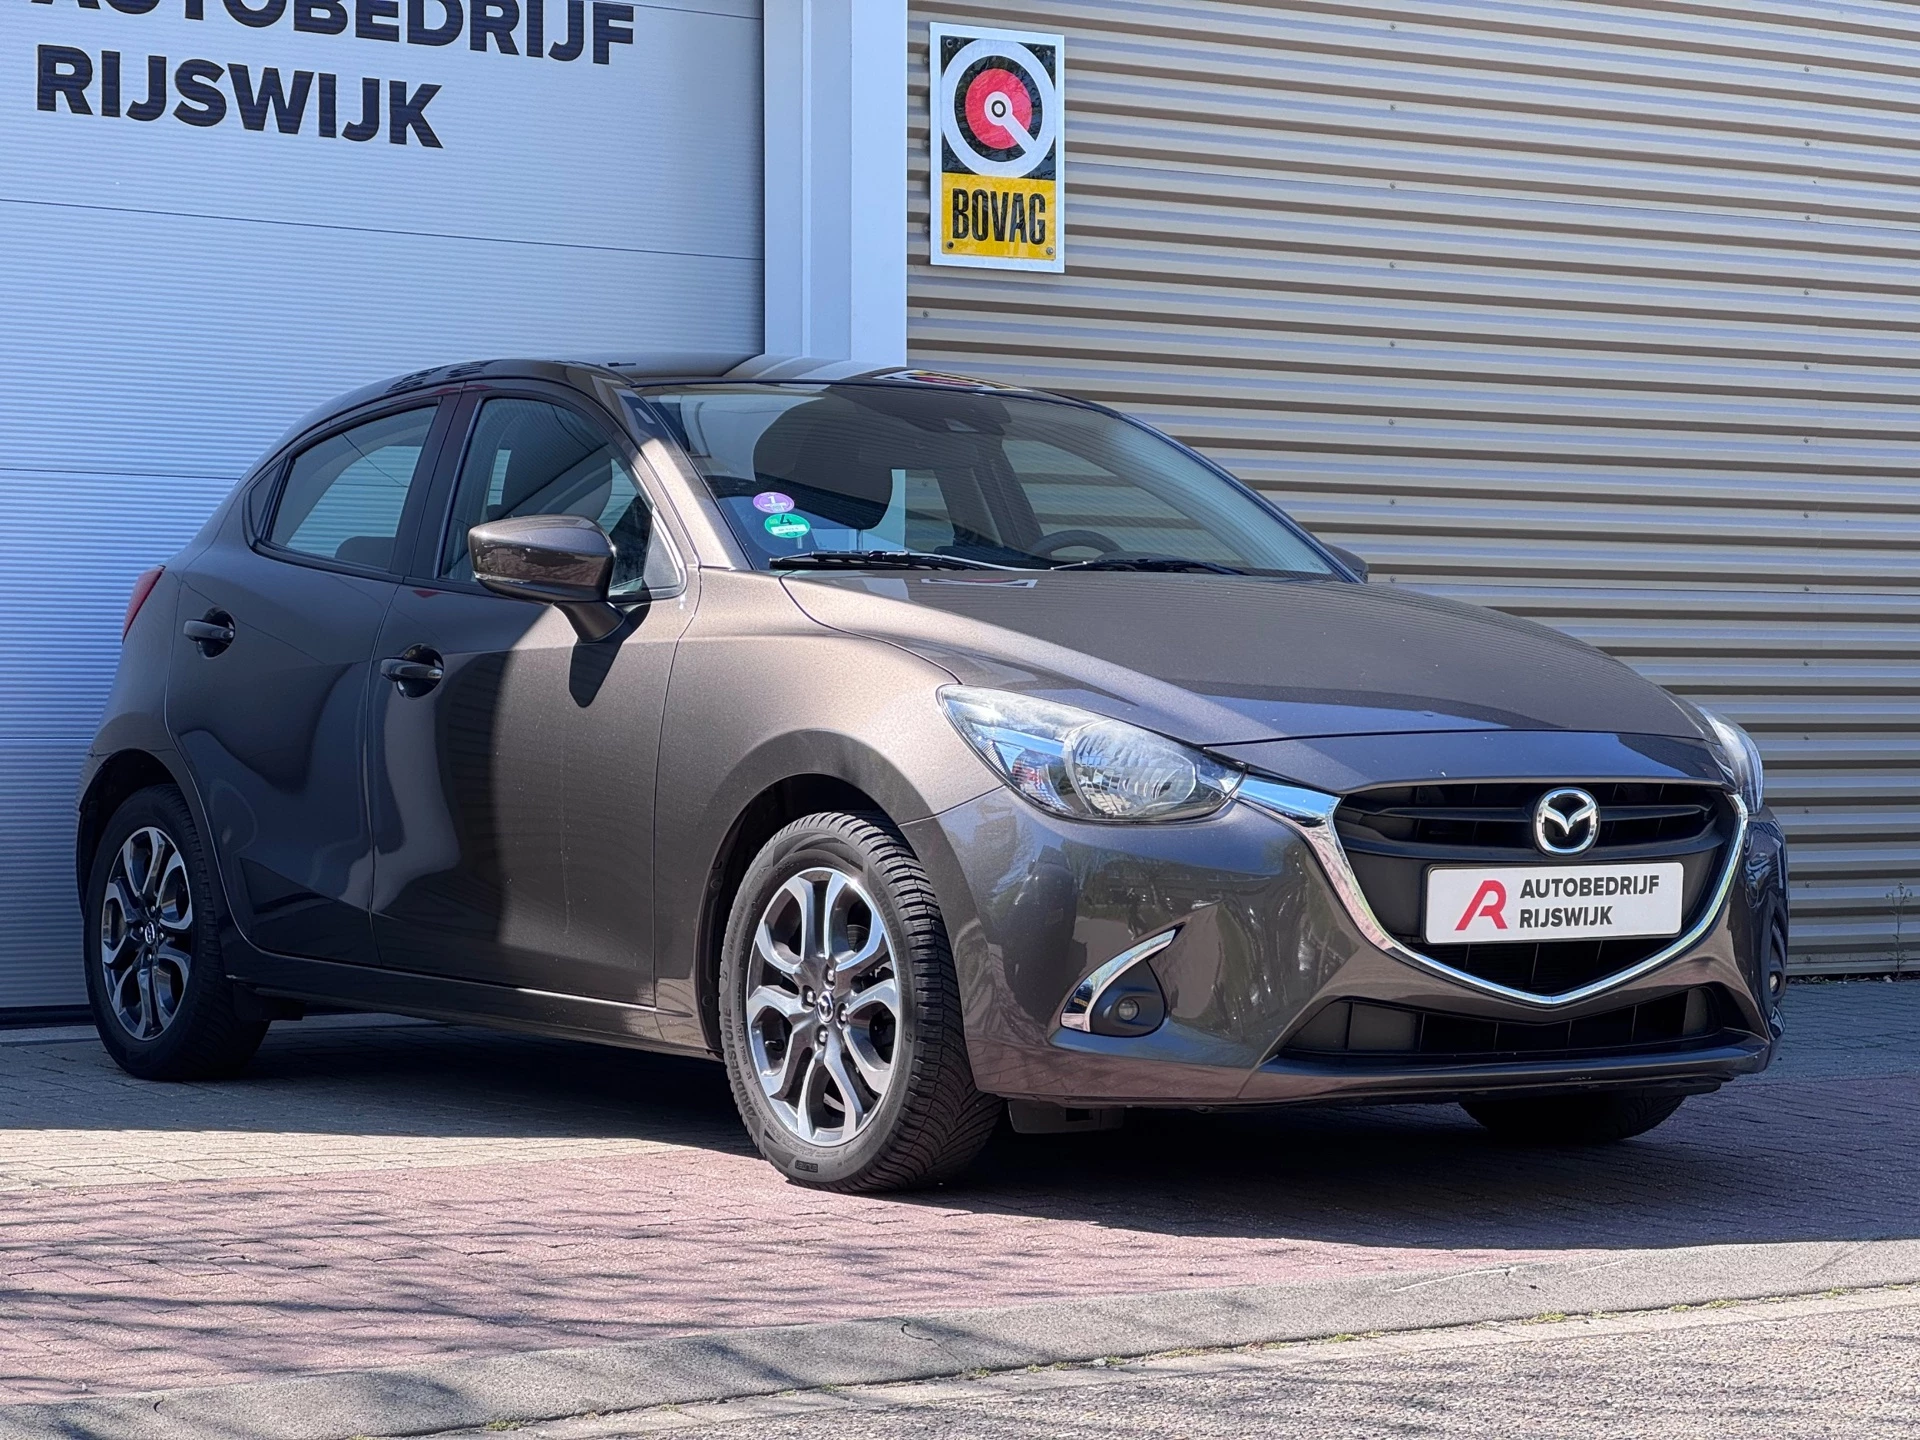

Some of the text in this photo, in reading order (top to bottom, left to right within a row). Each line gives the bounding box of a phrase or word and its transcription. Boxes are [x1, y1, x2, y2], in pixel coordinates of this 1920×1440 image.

[30, 0, 635, 65] BEDRIJF
[37, 44, 443, 149] RIJSWIJK
[952, 188, 1046, 245] BOVAG
[779, 514, 793, 525] 4
[1519, 875, 1660, 899] AUTOBEDRIJF
[1519, 906, 1613, 928] RIJSWIJK
